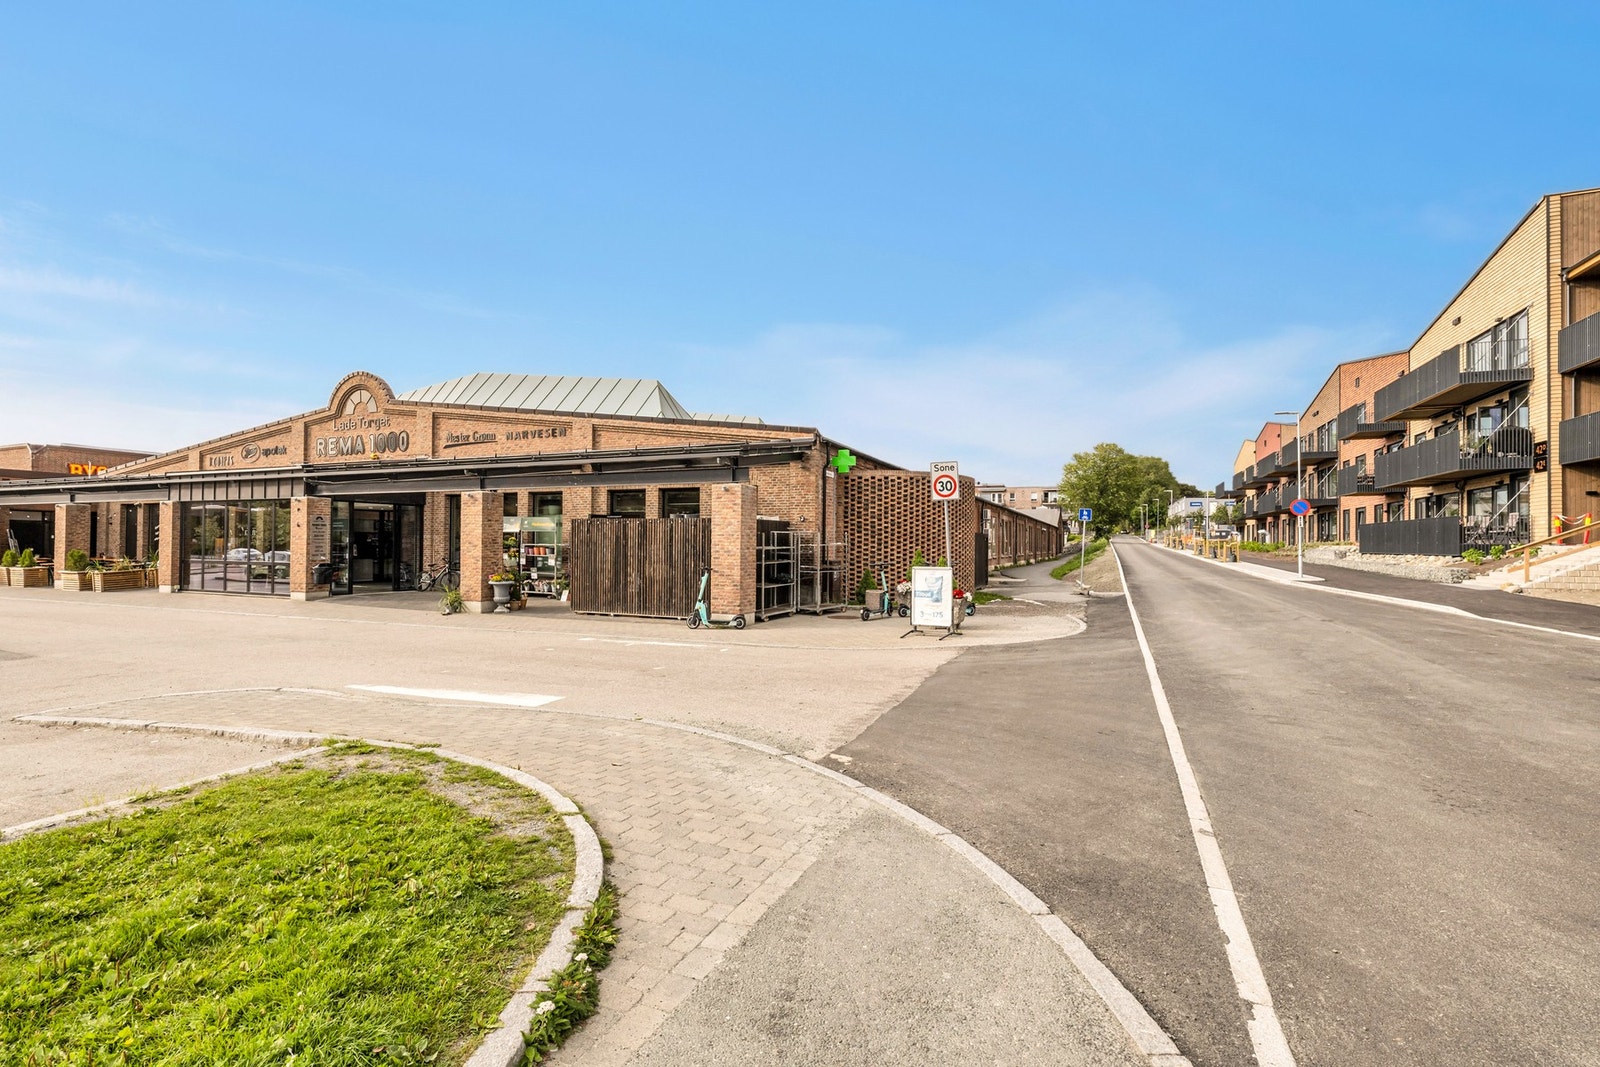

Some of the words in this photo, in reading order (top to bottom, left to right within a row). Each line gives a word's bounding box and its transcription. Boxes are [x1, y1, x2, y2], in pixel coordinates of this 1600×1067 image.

[332, 418, 357, 431] Lade
[359, 415, 391, 430] Torget
[506, 427, 568, 440] NARVESEN
[316, 434, 366, 457] REMA
[369, 430, 410, 453] 1000
[261, 445, 288, 458] apotek
[933, 464, 955, 472] Sone
[938, 480, 953, 492] 30
